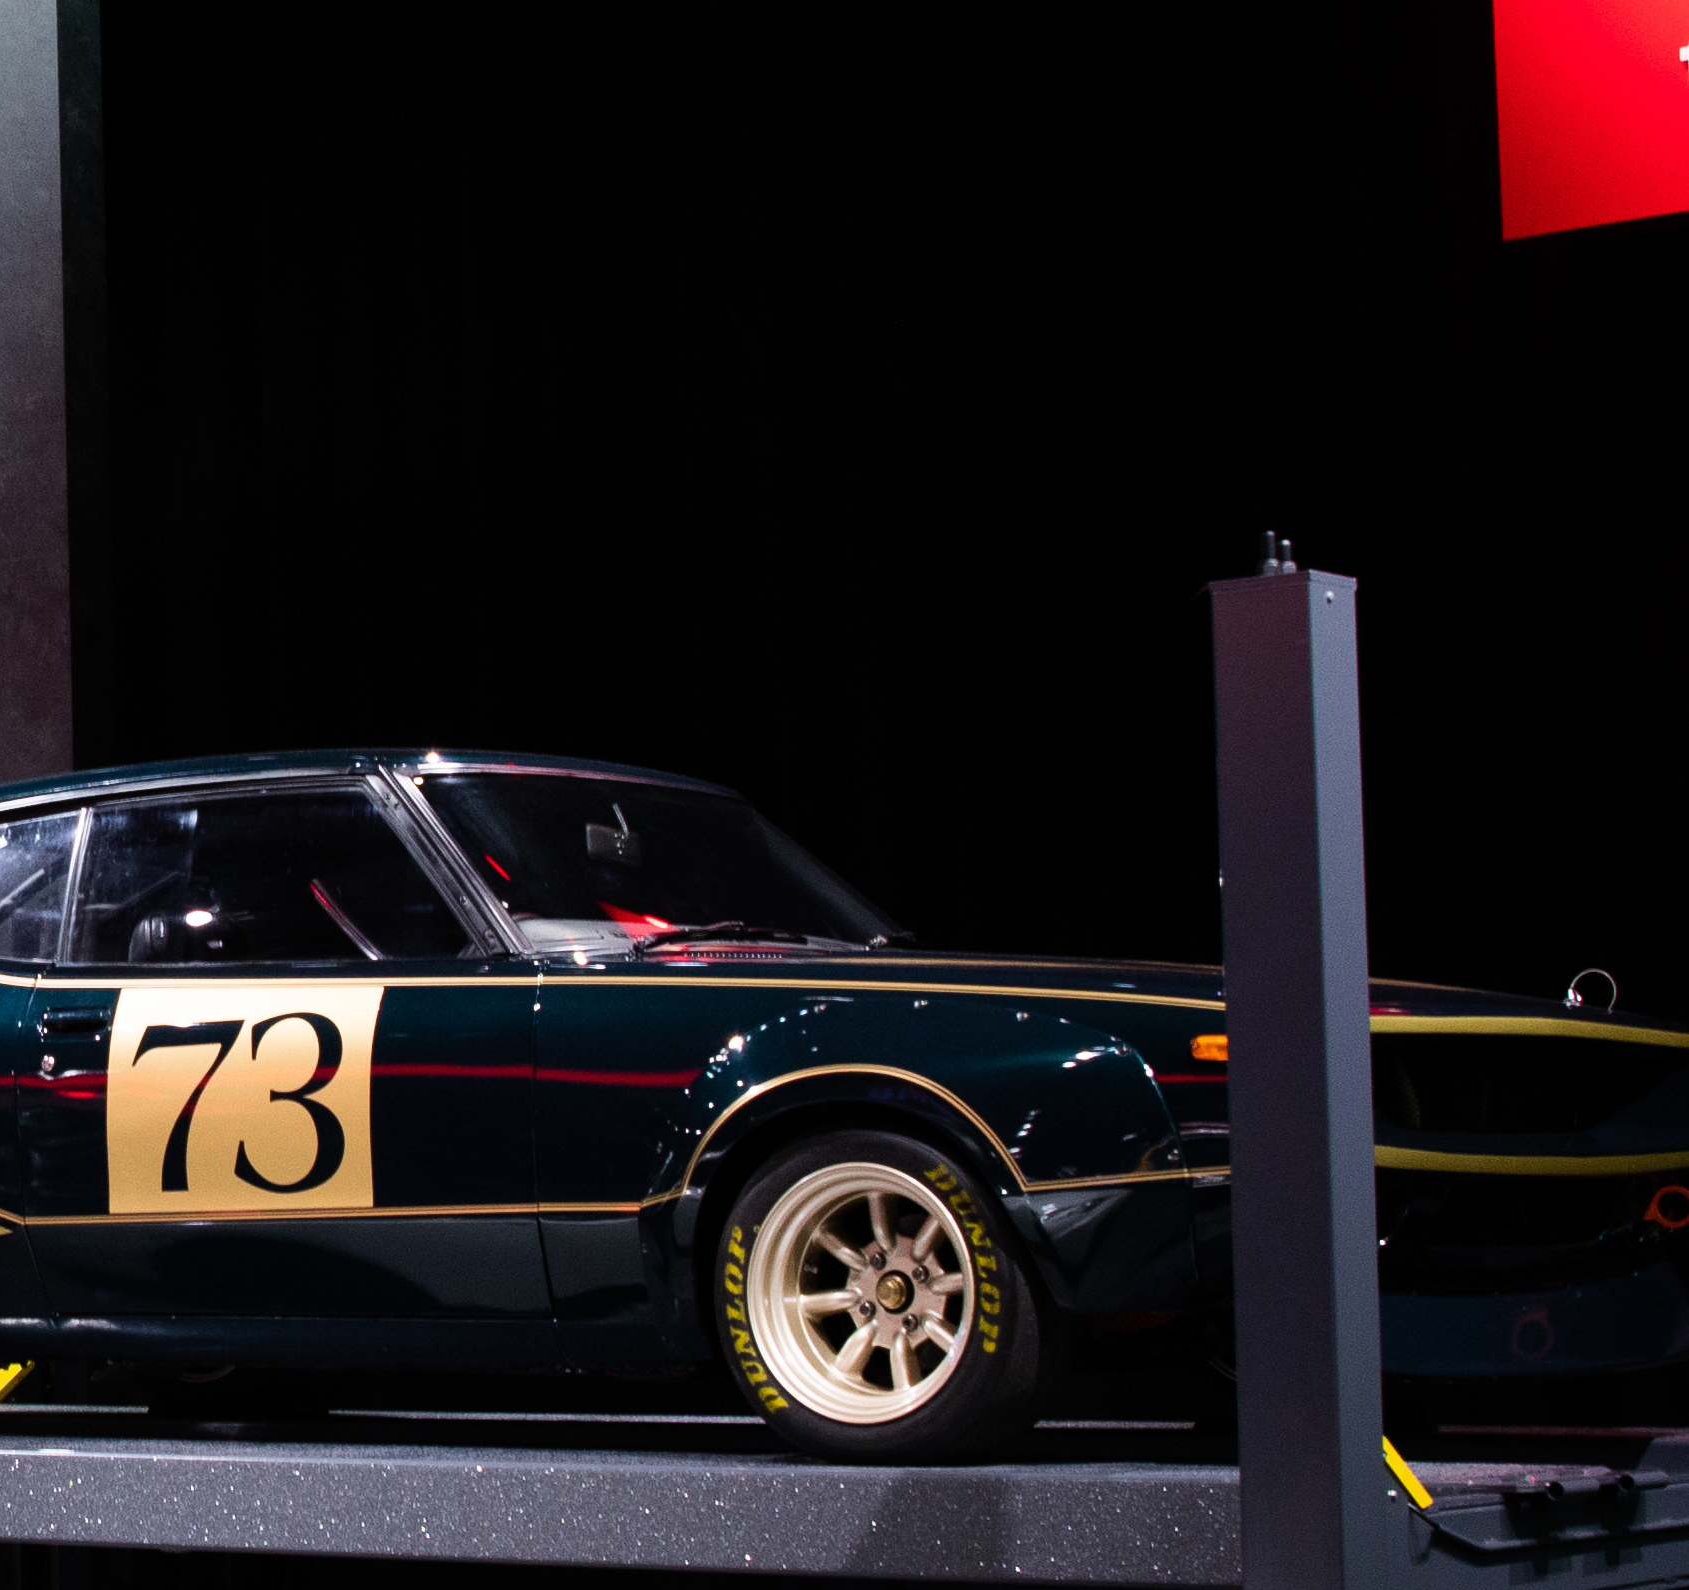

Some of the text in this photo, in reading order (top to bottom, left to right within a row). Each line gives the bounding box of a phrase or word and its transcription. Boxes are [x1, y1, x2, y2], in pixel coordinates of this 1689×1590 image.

[131, 1011, 346, 1195] 73
[724, 1225, 790, 1413] DUNLOP
[924, 1163, 1002, 1354] DUNLOP
